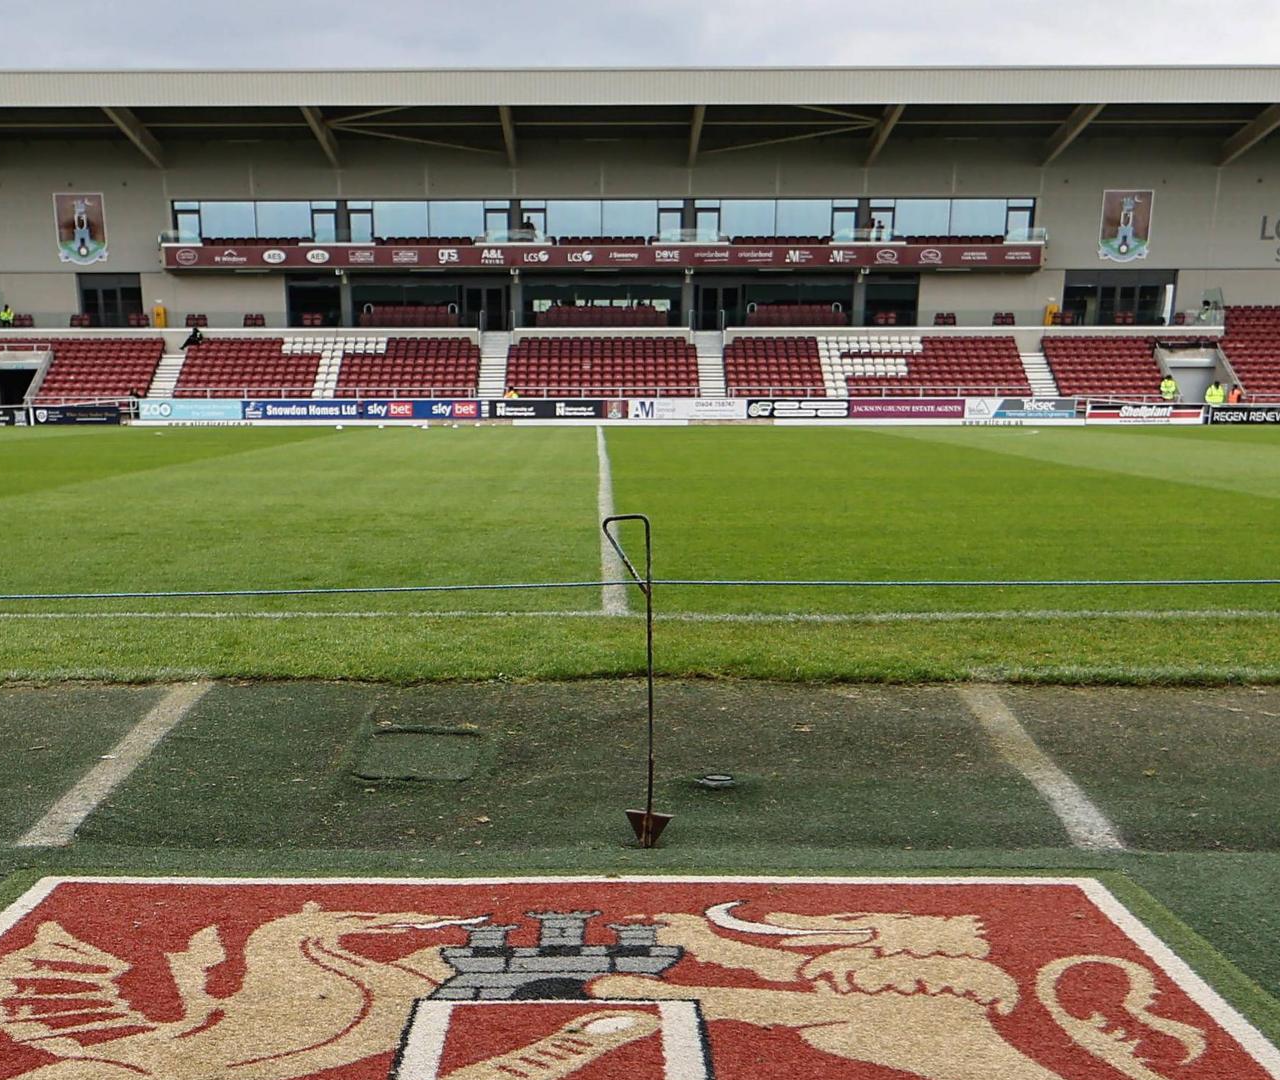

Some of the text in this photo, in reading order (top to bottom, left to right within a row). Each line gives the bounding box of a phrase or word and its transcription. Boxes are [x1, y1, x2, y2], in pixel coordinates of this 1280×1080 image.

[524, 253, 538, 262] LCS
[568, 253, 582, 262] LCS
[266, 402, 357, 416] Snowdon Homes Ltd
[367, 402, 412, 417] sky bet
[431, 401, 476, 417] sky bet
[853, 404, 882, 413] JACKSON
[882, 404, 911, 413] GRUNDY
[911, 404, 936, 413] ESTATE
[937, 404, 962, 412] AGENTS
[1212, 407, 1247, 422] REGEN
